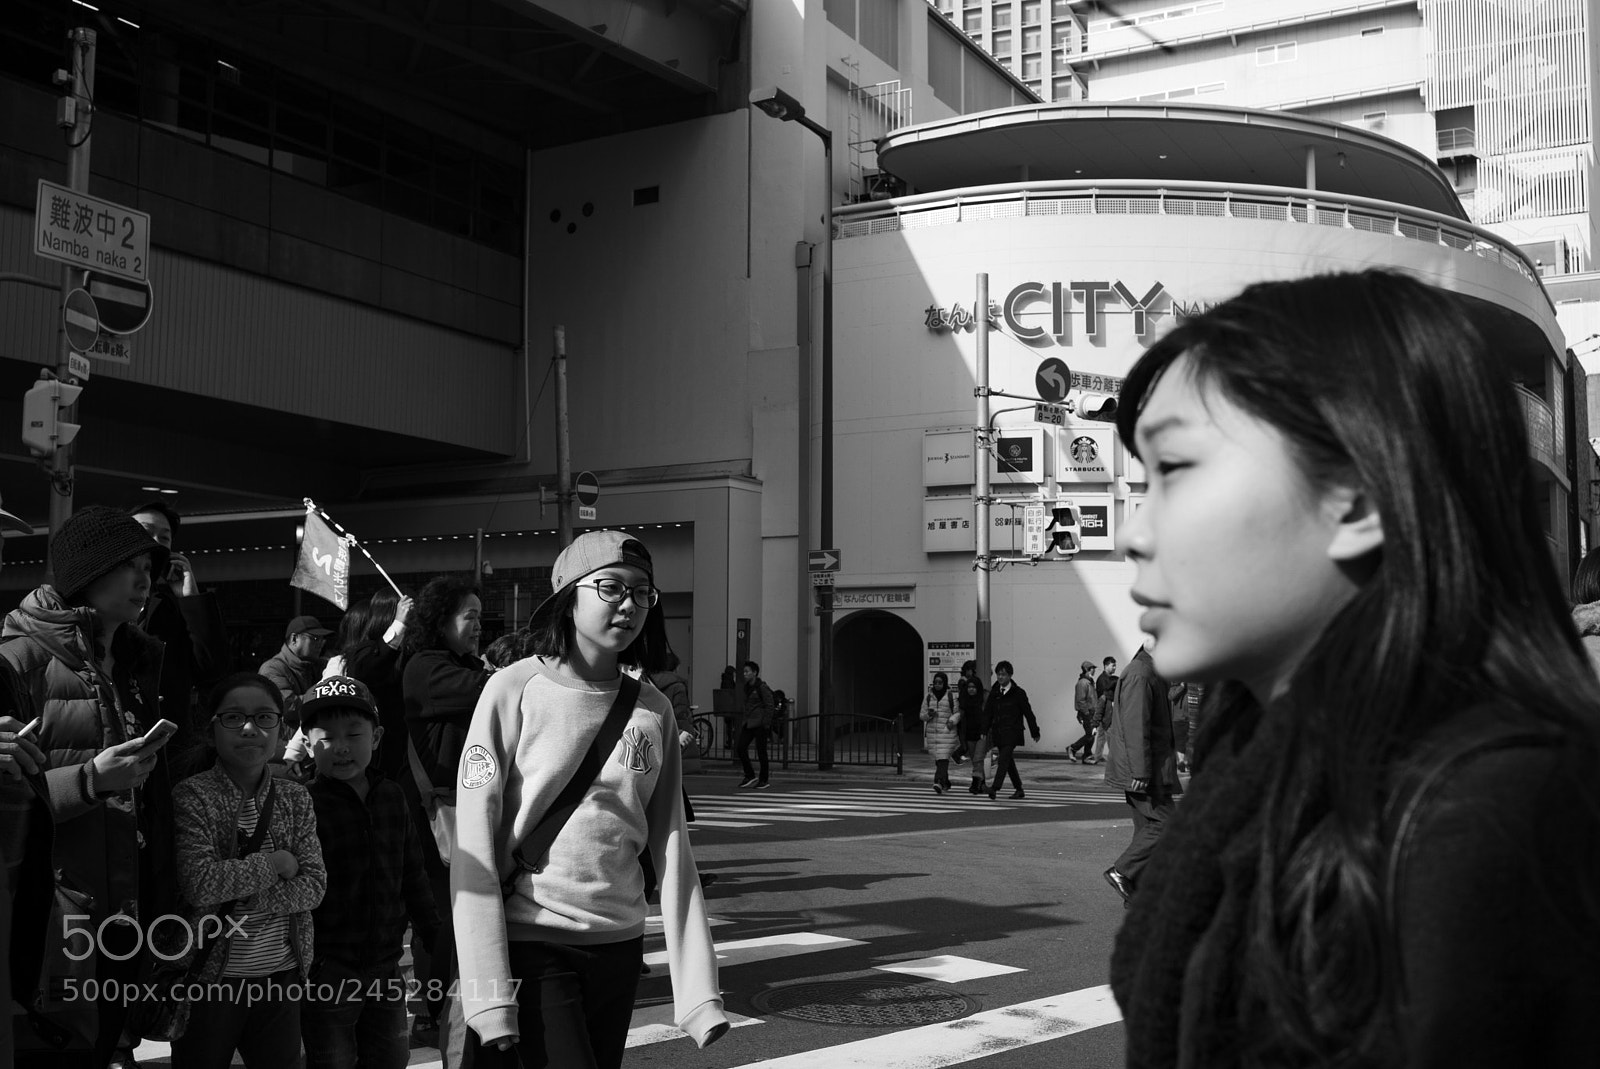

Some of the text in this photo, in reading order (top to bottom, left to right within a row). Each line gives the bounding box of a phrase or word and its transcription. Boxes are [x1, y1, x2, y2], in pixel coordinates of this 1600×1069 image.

[50, 194, 135, 250] 難波中2
[42, 229, 142, 274] Namba naka 2
[1003, 280, 1164, 338] CITY
[88, 340, 129, 358] 転車を除く
[315, 680, 356, 699] TEXAS
